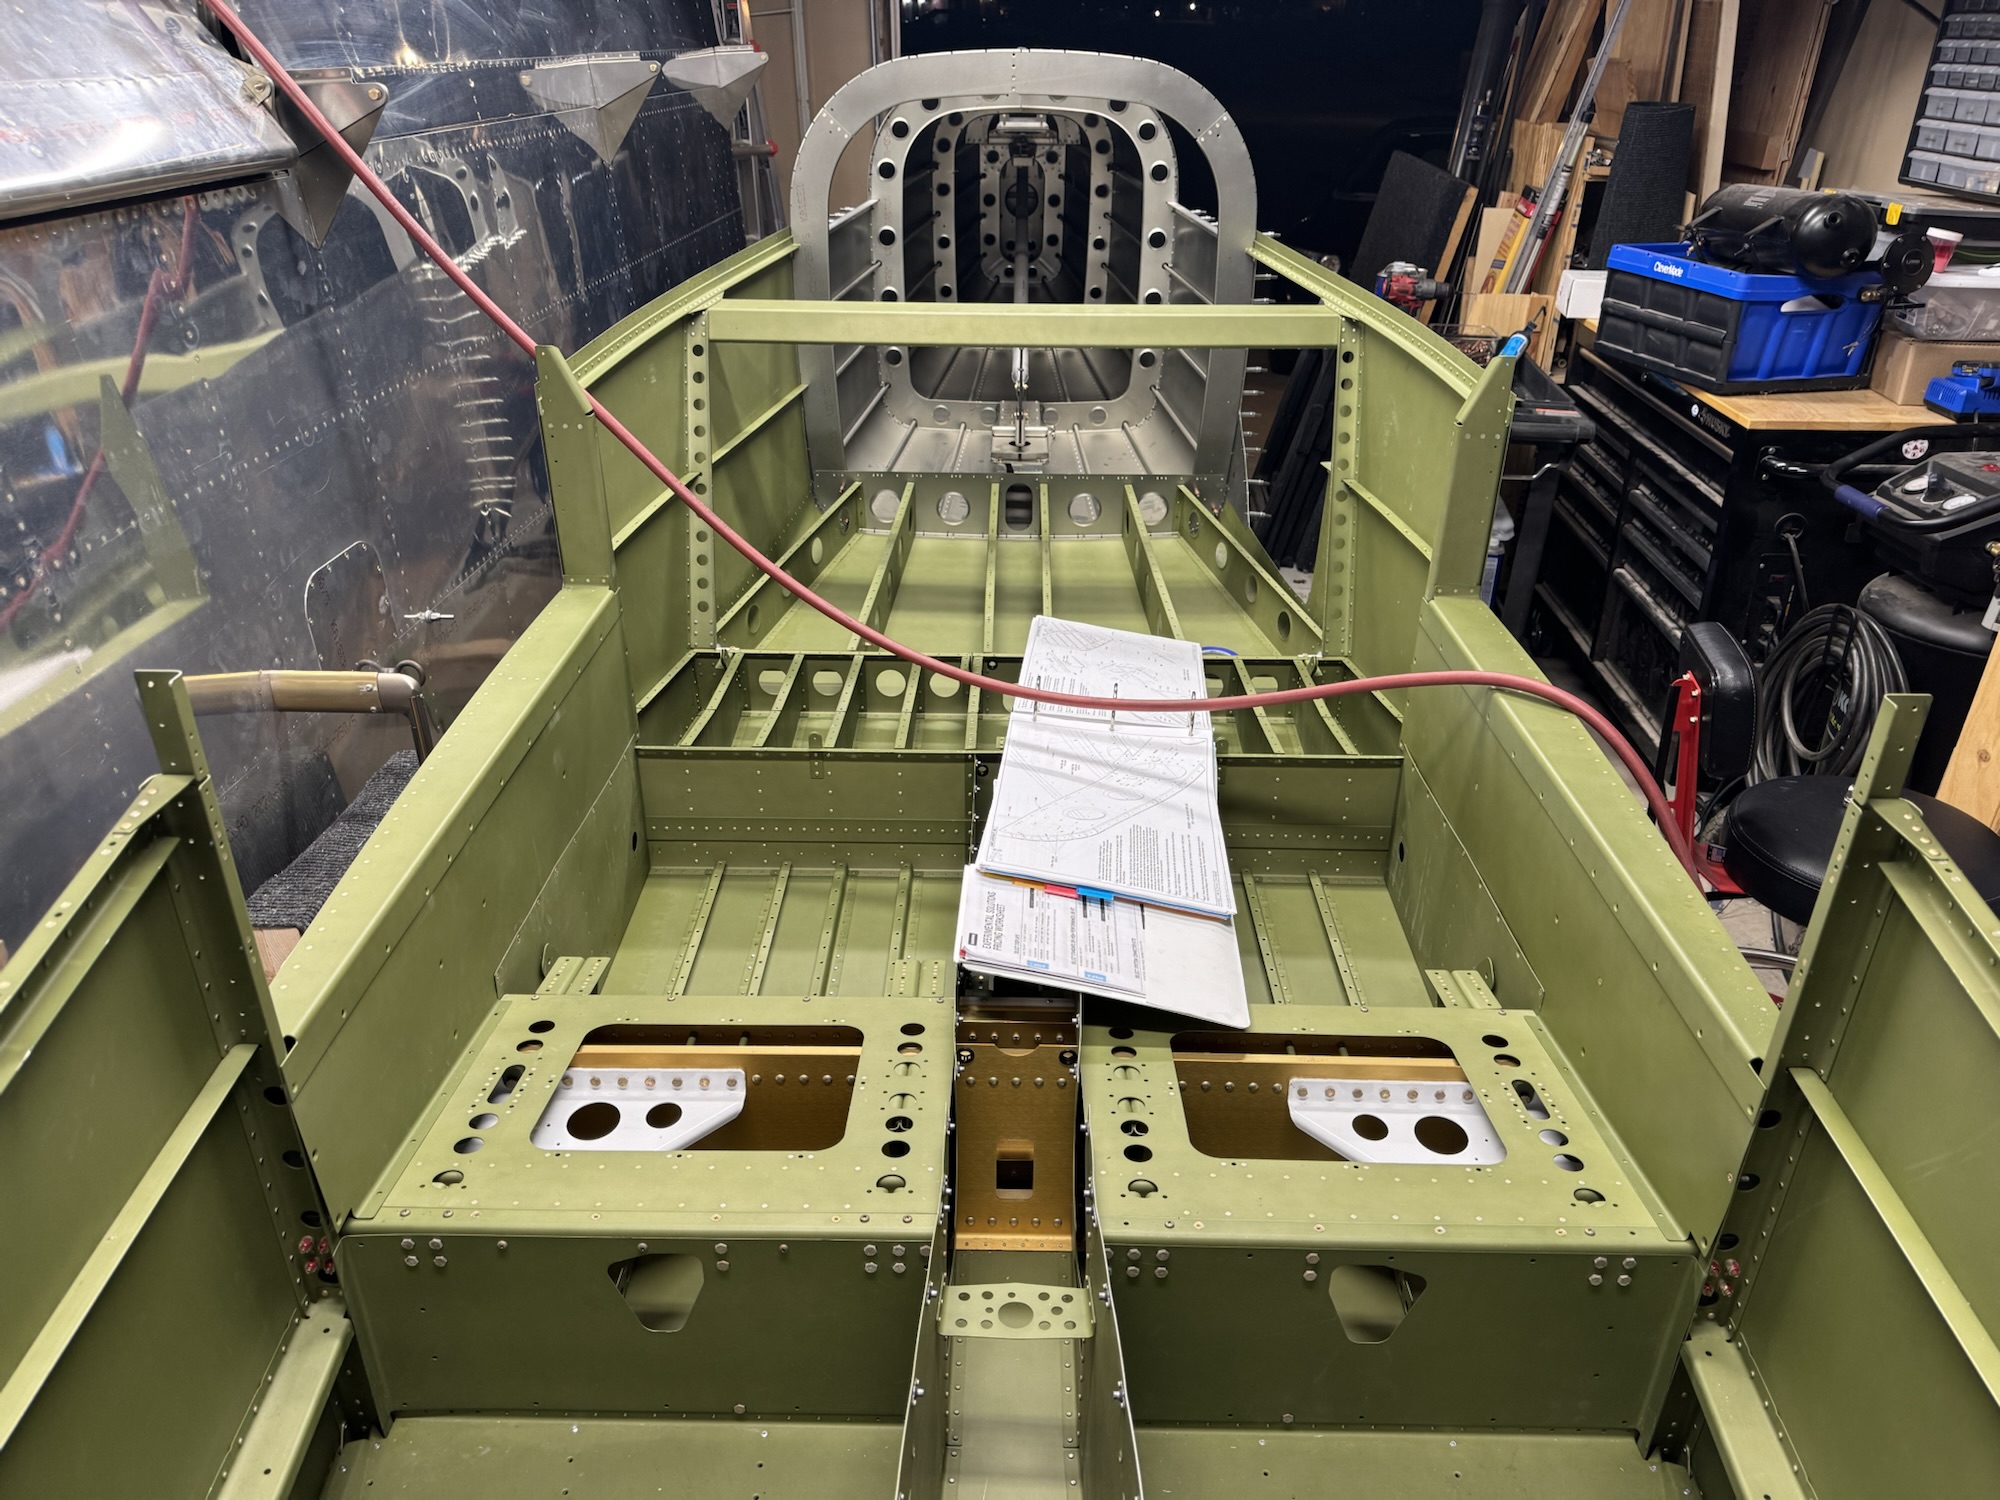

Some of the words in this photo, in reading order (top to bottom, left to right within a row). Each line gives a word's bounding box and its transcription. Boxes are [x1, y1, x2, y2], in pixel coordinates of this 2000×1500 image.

[1653, 261, 1684, 277] CleverMade
[986, 891, 997, 914] SOLUTIONS
[995, 904, 1006, 931] WORKSHEET
[982, 913, 995, 949] EXPERIMENTAL
[992, 931, 1004, 951] PRICING
